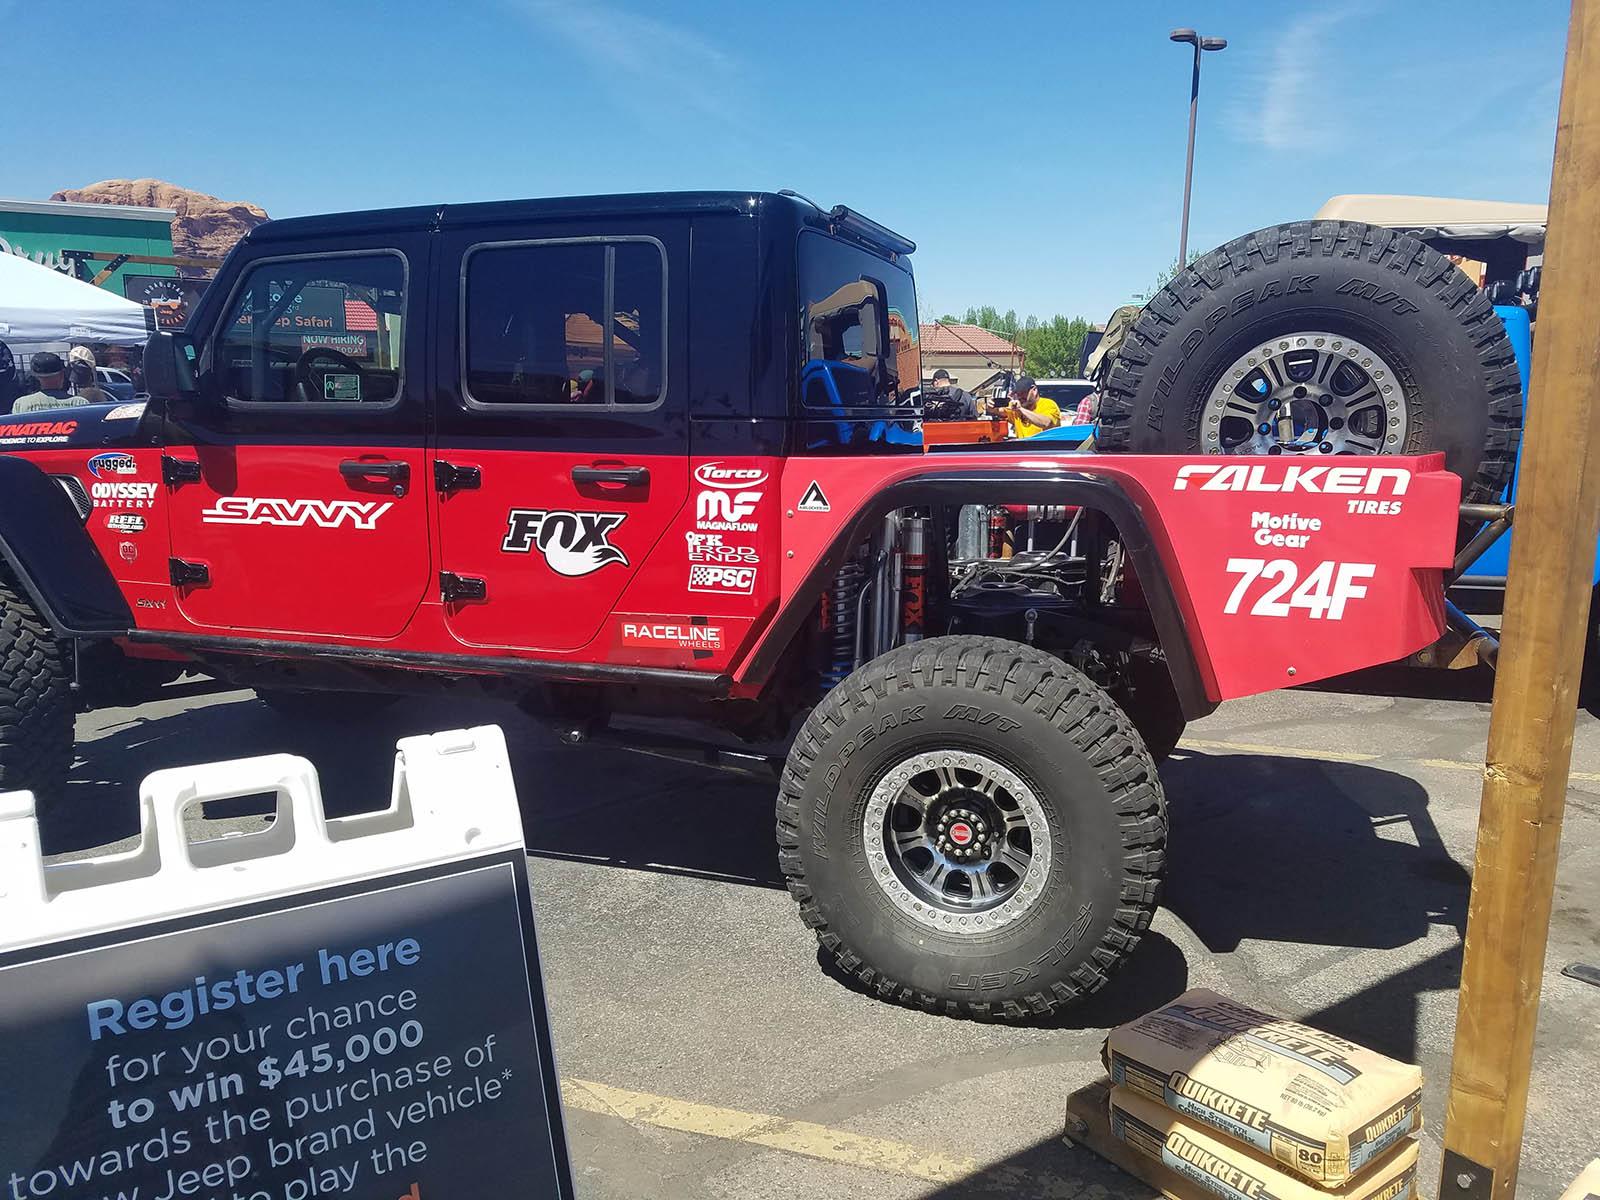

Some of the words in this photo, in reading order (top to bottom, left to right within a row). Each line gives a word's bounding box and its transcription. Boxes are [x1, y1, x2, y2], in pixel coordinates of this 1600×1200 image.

[295, 315, 333, 328] Safari
[303, 335, 329, 345] NOW
[331, 336, 364, 345] HIRING
[1147, 274, 1320, 431] WILDPEAK
[1336, 277, 1421, 316] M/T
[0, 421, 78, 436] YNATRAC
[91, 483, 158, 499] ODYSSEY
[1173, 464, 1412, 495] FALKEN
[93, 500, 154, 508] BATTERY
[202, 497, 394, 529] SAVVY
[1347, 500, 1402, 515] TIRES
[109, 515, 144, 525] REEL
[500, 508, 628, 556] FOX
[697, 521, 759, 532] MAGNAFLOW
[1251, 512, 1322, 531] Motive
[1254, 529, 1310, 548] Gear
[689, 554, 760, 563] ENDS
[708, 568, 752, 588] PSC
[1223, 558, 1376, 620] 724F
[624, 624, 720, 641] RACELINE
[679, 640, 721, 649] WHEELS
[812, 704, 926, 859] WILDPEAK
[943, 704, 1022, 732] M/T
[87, 962, 304, 1041] Register
[318, 938, 421, 985] here
[105, 1050, 166, 1087] for
[181, 1024, 271, 1074] your
[286, 989, 417, 1039] chance
[108, 1098, 155, 1129] to
[168, 1072, 244, 1112] win
[258, 1020, 423, 1089] $45,000
[1167, 1071, 1271, 1133] QUIKRETE
[8, 1128, 191, 1200] towards
[205, 1107, 271, 1144] the
[285, 1055, 452, 1127] purchase
[464, 1034, 496, 1068] of
[1365, 1104, 1408, 1143] QUIKRETE
[154, 1155, 251, 1200] Jeep
[268, 1108, 376, 1168] brand
[1165, 1131, 1266, 1200] QUIKRETE
[1299, 1149, 1323, 1164] 80
[284, 1160, 359, 1200] play
[371, 1140, 427, 1175] the
